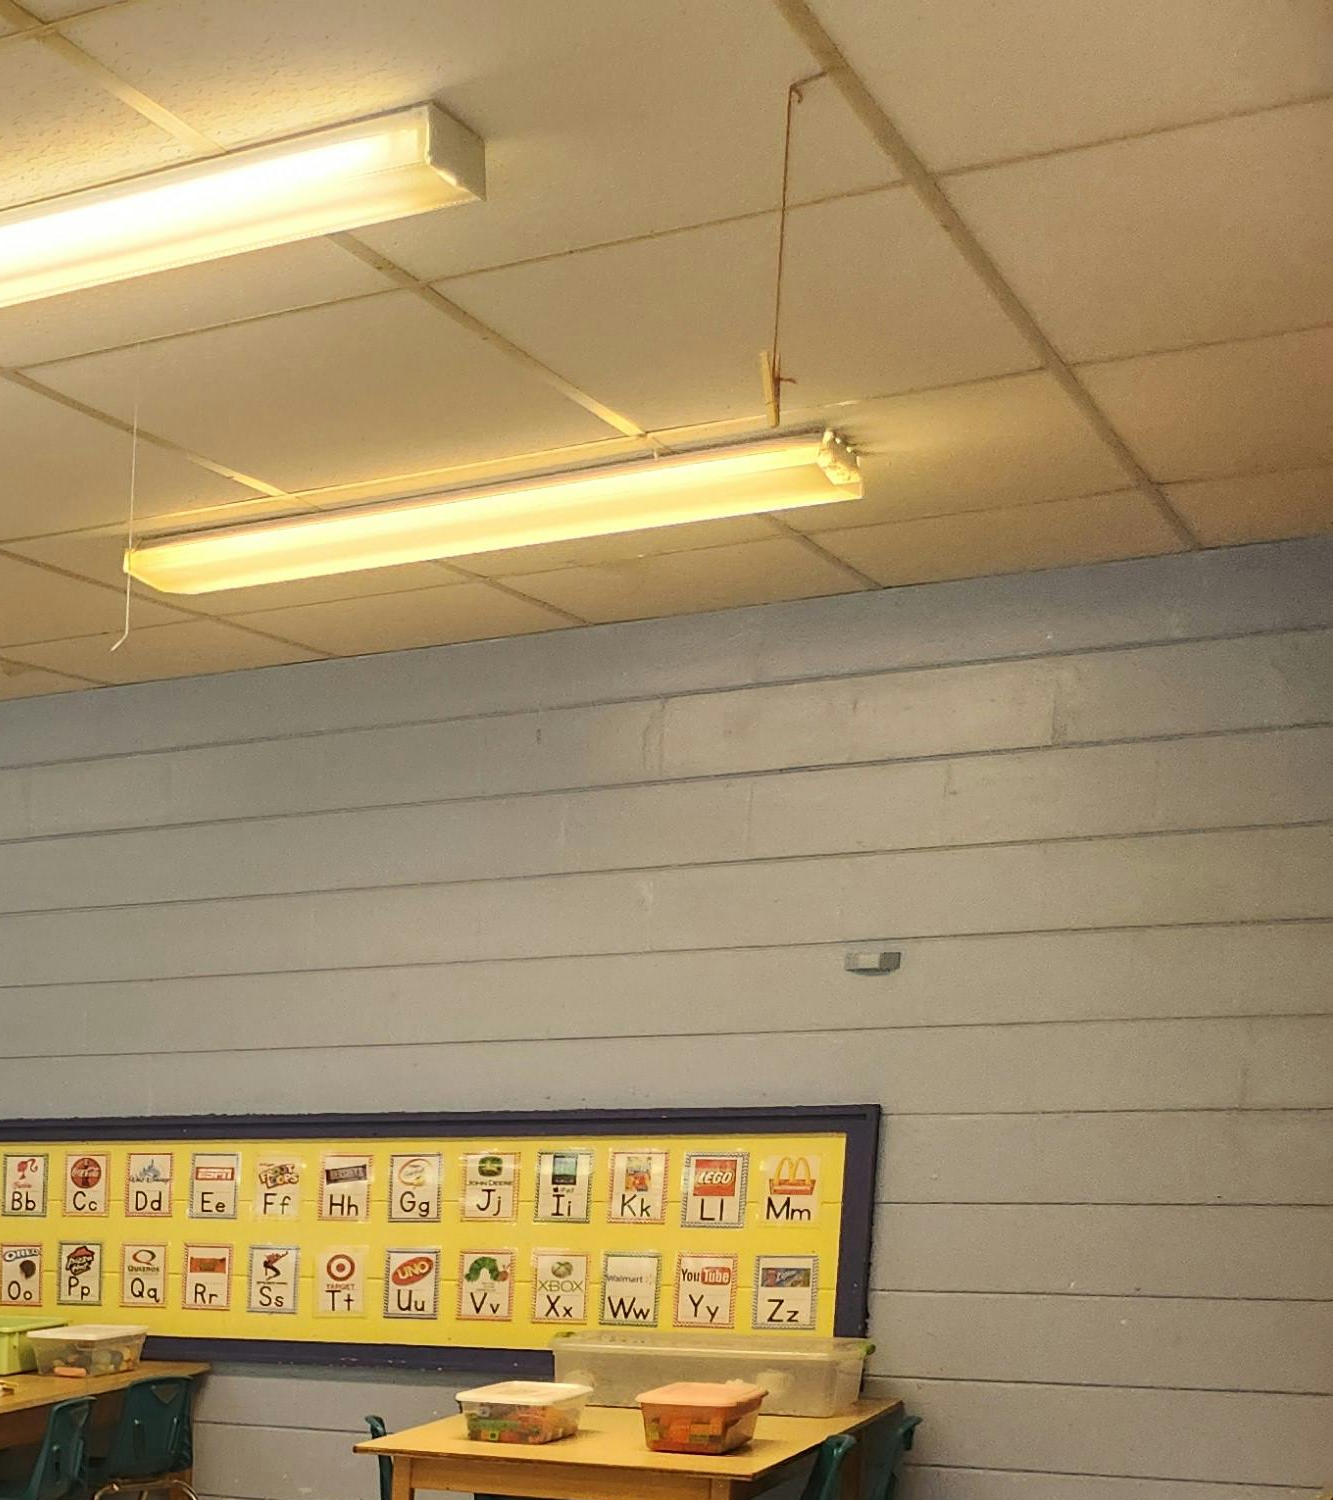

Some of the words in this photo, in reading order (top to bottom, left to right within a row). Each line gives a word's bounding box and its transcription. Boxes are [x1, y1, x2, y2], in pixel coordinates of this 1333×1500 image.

[696, 1171, 733, 1185] LEGO
[11, 1191, 36, 1211] Bb
[73, 1191, 98, 1211] Cc
[134, 1191, 162, 1212] Dd
[201, 1192, 226, 1213] Ee
[262, 1192, 291, 1216] Ff
[329, 1193, 359, 1216] Hh
[400, 1191, 430, 1217] Gg
[476, 1189, 502, 1216] Jj
[551, 1194, 571, 1217] Ii
[620, 1194, 651, 1217] Kk
[700, 1198, 723, 1221] Ll
[766, 1196, 811, 1221] Mm
[396, 1260, 429, 1280] UNO
[7, 1280, 32, 1301] Oo
[68, 1276, 90, 1300] Pp
[130, 1277, 160, 1303] Qq
[194, 1283, 218, 1304] Rr
[259, 1286, 284, 1307] Ss
[537, 1280, 583, 1293] XBOX
[325, 1289, 355, 1311] Tt
[396, 1289, 425, 1311] Uu
[470, 1292, 500, 1314] Vv
[545, 1295, 573, 1317] Xx
[608, 1295, 650, 1320] Ww
[688, 1294, 719, 1322] Yy
[767, 1298, 799, 1323] Zz
